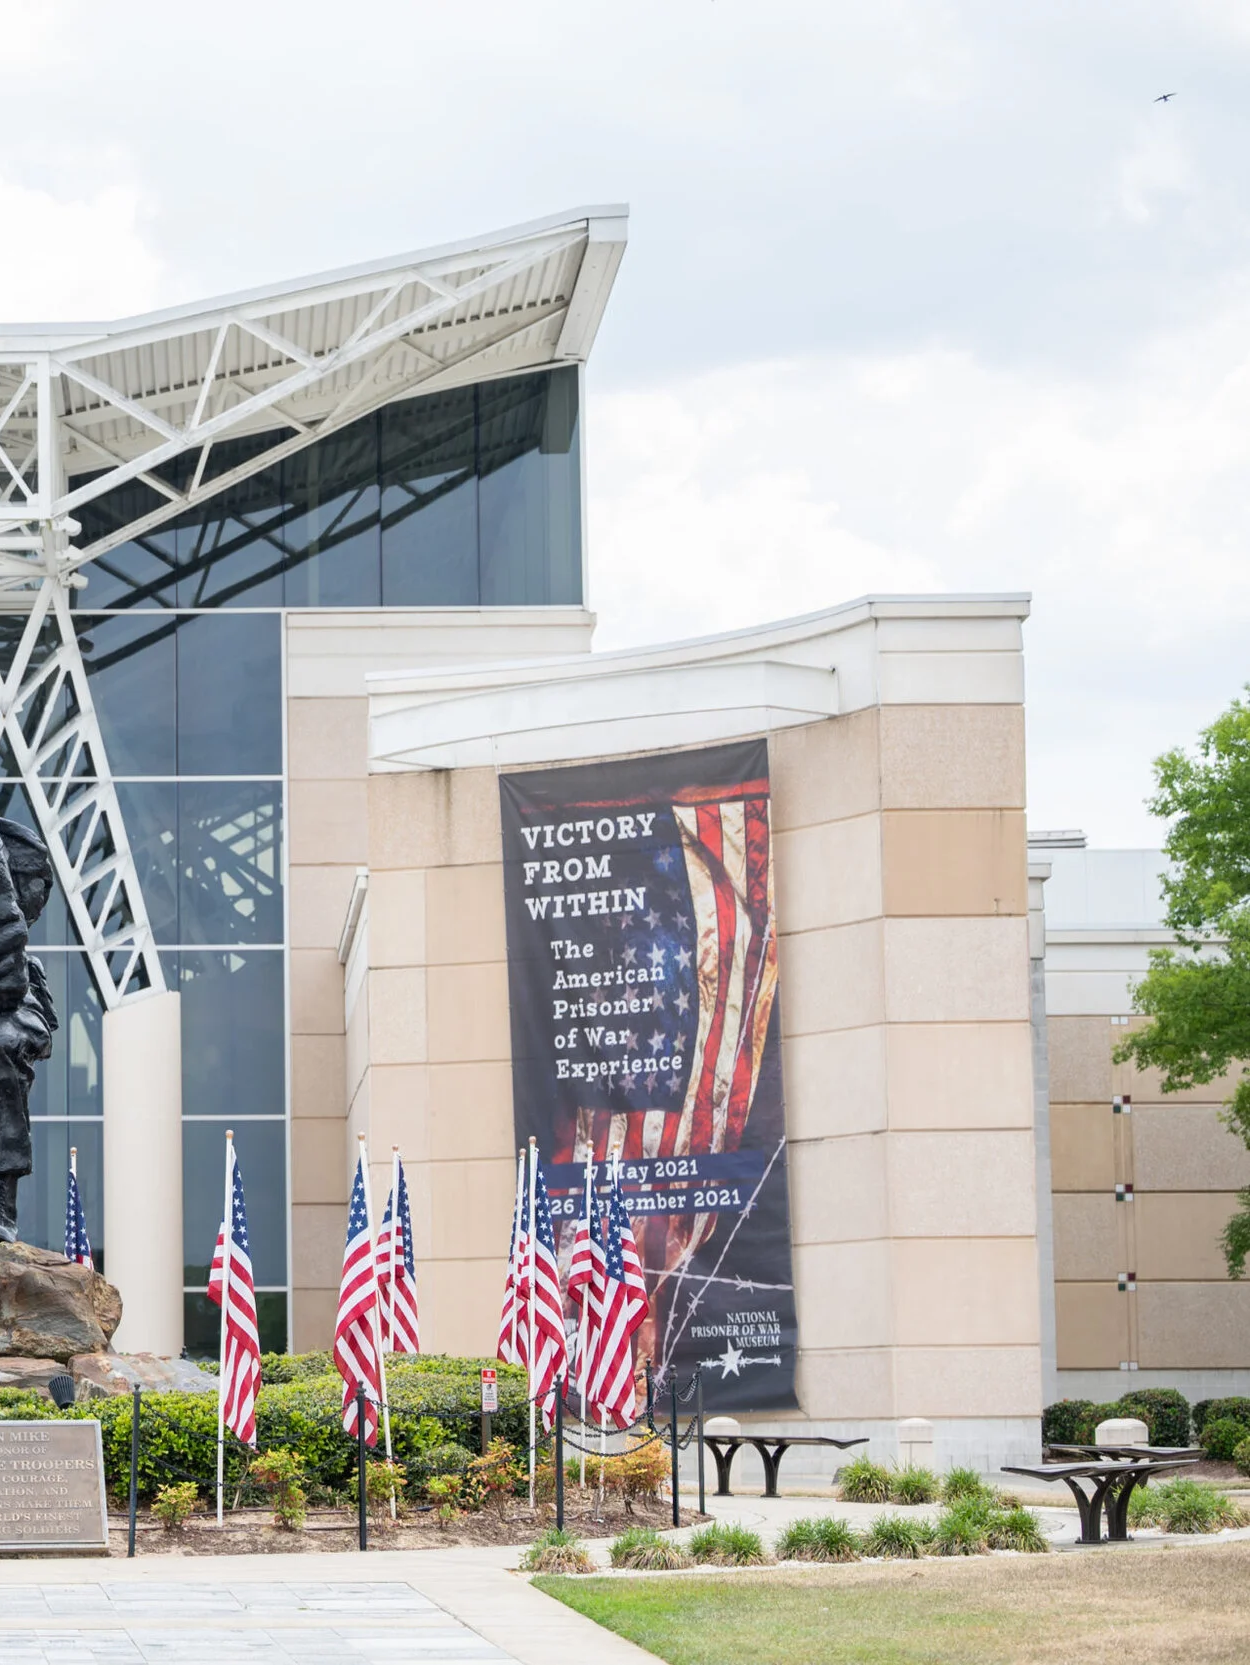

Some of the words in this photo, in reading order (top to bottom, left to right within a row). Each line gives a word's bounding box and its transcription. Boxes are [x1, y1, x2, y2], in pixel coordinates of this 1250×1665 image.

[520, 812, 656, 850] VICTORY
[523, 855, 611, 885] FROM
[525, 887, 646, 920] WITHIN
[550, 940, 594, 960] The
[552, 964, 666, 990] American
[552, 996, 653, 1019] Prisoner
[554, 1029, 578, 1049] of
[584, 1027, 631, 1047] War
[556, 1055, 683, 1083] Experience
[605, 1161, 649, 1183] May
[655, 1159, 699, 1178] 2021
[550, 1198, 574, 1215] 26
[694, 1189, 741, 1207] 2021
[726, 1311, 779, 1324] NATIONAL
[691, 1324, 740, 1338] PRISONER
[741, 1324, 756, 1336] OF
[757, 1323, 781, 1335] WAR
[736, 1335, 780, 1349] MUSEUM
[9, 1431, 50, 1442] MIKE
[32, 1446, 47, 1455] OF
[10, 1459, 95, 1471] TROOPERS
[2, 1474, 68, 1484] COURAGE,
[41, 1487, 68, 1495] AND
[15, 1500, 52, 1509] MAKE
[56, 1499, 93, 1508] THEM
[34, 1511, 82, 1521] FINEST
[15, 1525, 81, 1535] SOLDIERS
